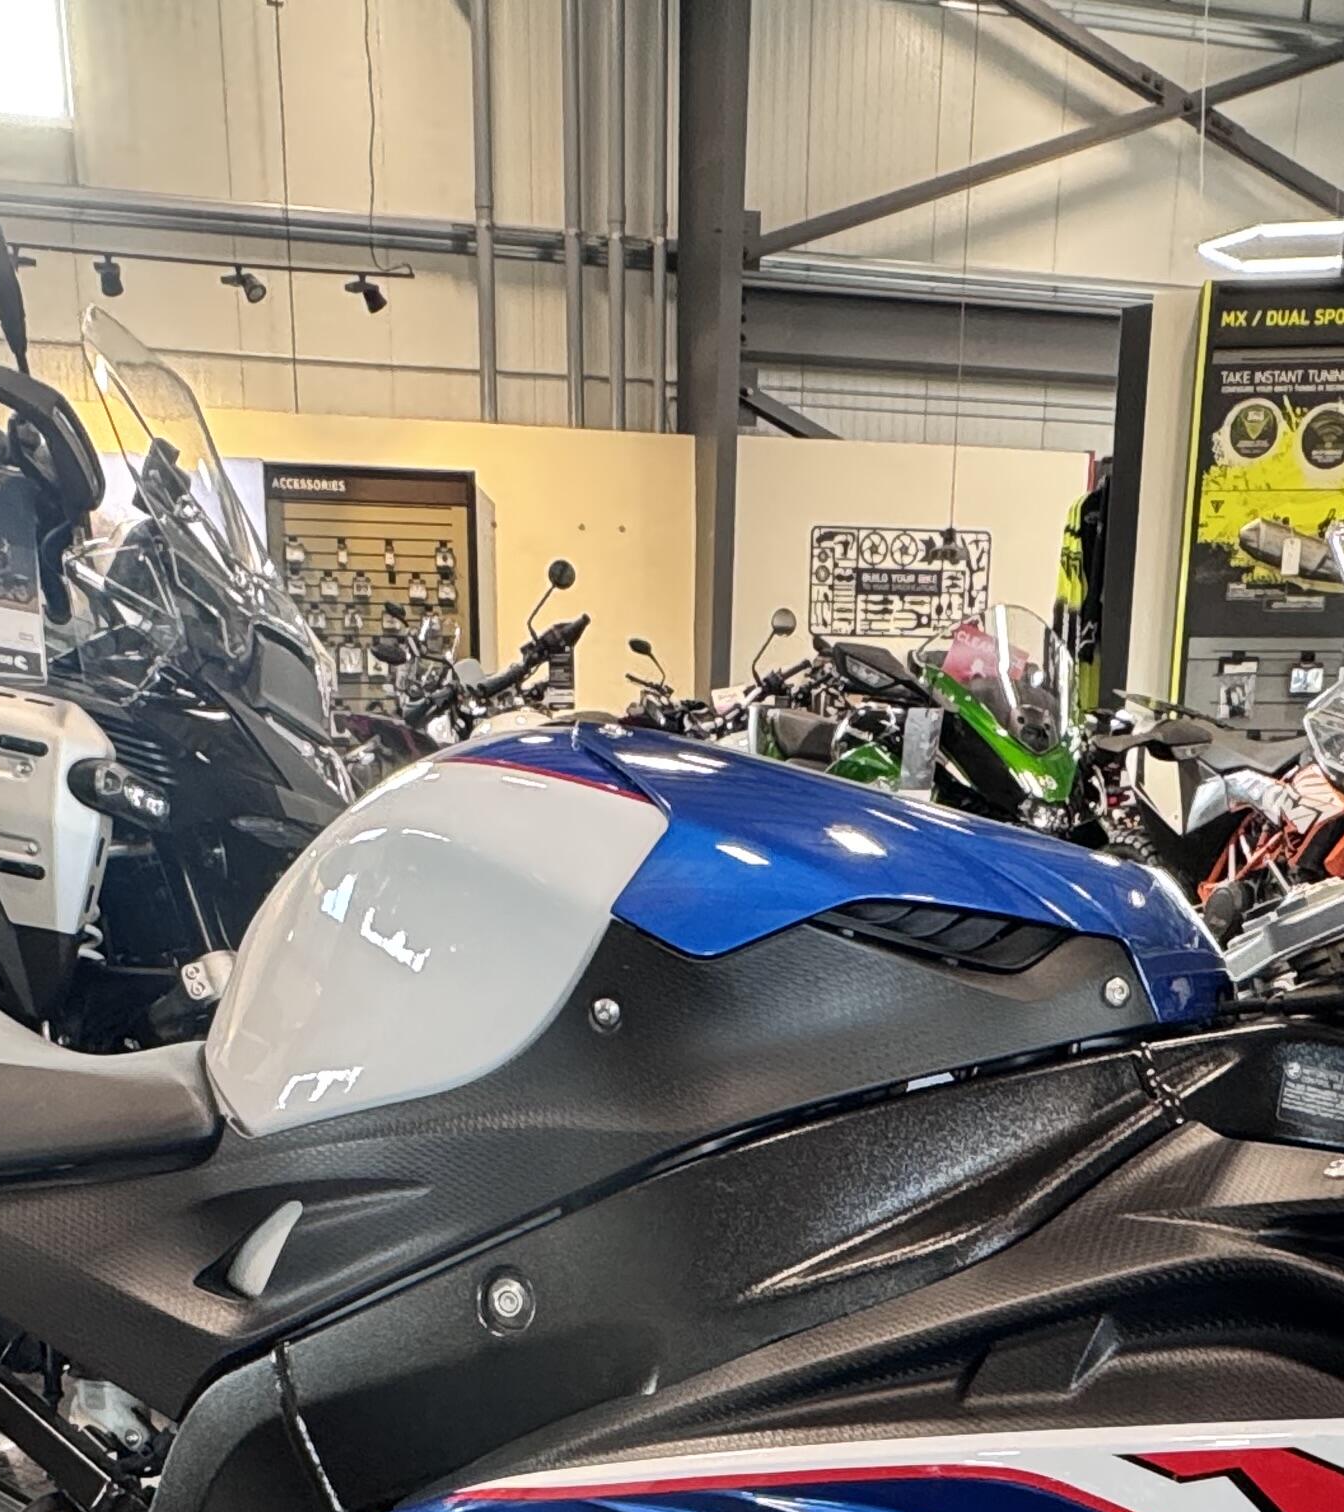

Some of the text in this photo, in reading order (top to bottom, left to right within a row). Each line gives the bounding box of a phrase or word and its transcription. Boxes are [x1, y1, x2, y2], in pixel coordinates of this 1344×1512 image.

[1221, 310, 1248, 327] MX
[1265, 309, 1310, 326] DUAL
[1220, 371, 1251, 385] TAKE
[1254, 369, 1305, 384] INSTANT
[272, 477, 346, 492] ACCESSORIES
